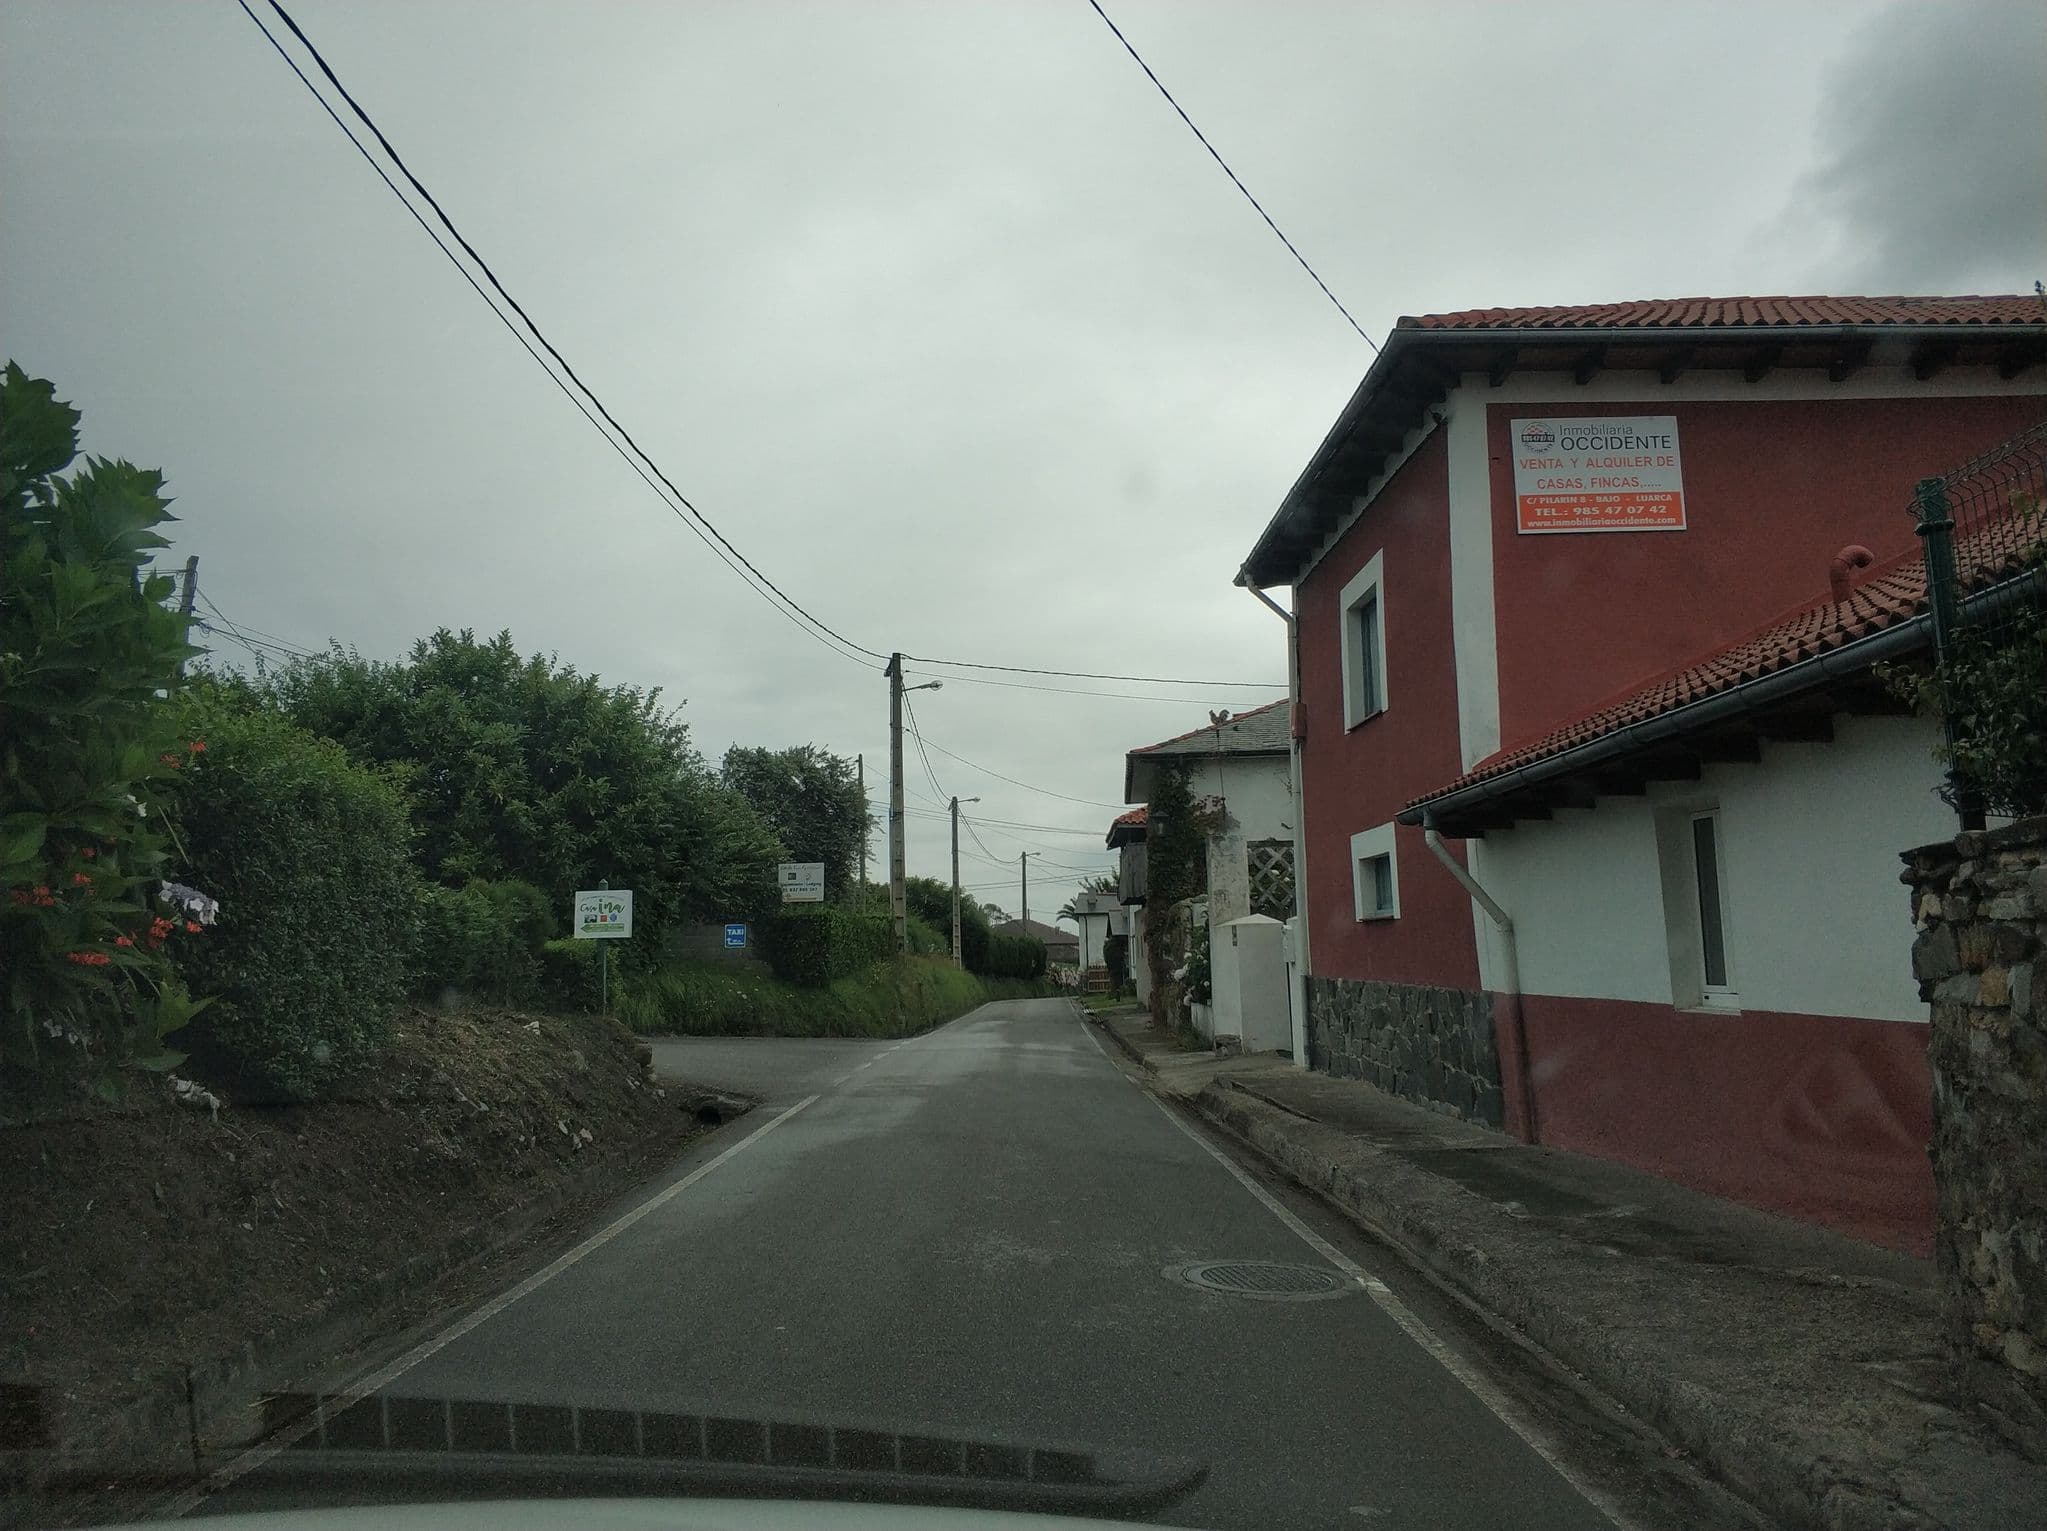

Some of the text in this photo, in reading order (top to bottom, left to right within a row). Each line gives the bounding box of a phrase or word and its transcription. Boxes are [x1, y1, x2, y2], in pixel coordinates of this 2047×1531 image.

[1560, 424, 1633, 435] Inmobiliaria
[1561, 435, 1672, 451] OCCIDENTE
[1520, 456, 1675, 470] VENTA Y ALQUILER DE
[1537, 478, 1587, 490] CASAS,
[1527, 497, 1536, 505] C/
[1596, 495, 1620, 503] BAJO
[1636, 494, 1672, 502] LUARCA
[1534, 508, 1568, 516] TEL.:
[1573, 507, 1599, 515] 985
[1627, 506, 1644, 514] 07
[1650, 505, 1667, 513] 42
[1527, 517, 1676, 528] www.inmobiliariaoccidente.com
